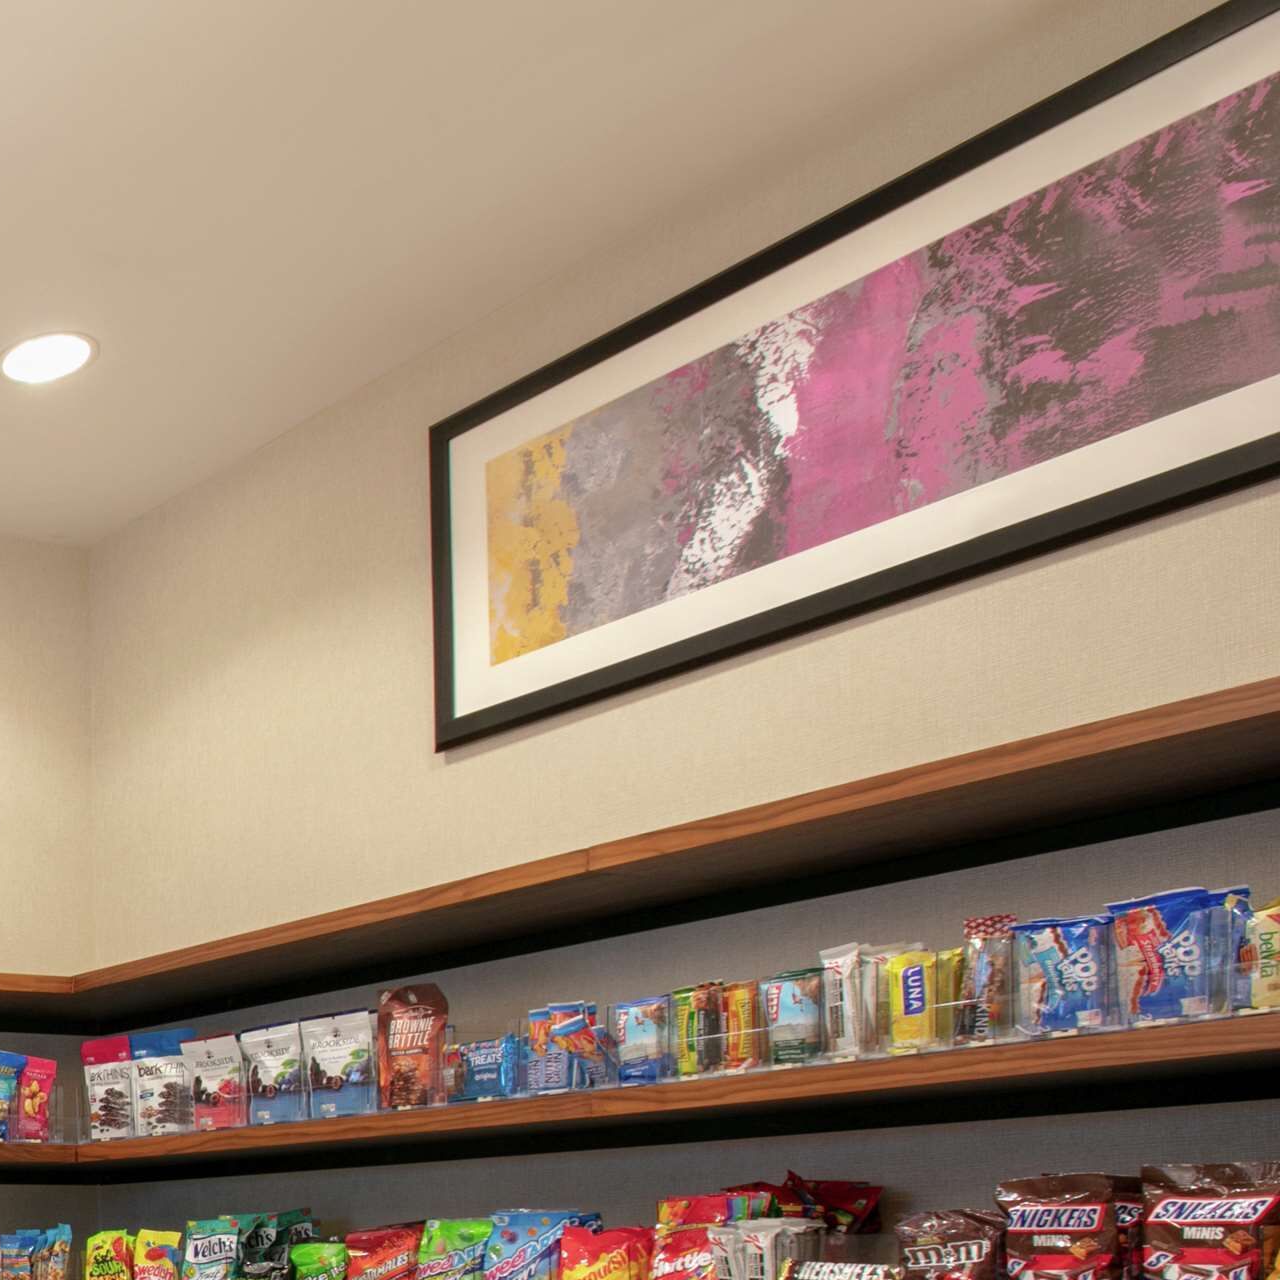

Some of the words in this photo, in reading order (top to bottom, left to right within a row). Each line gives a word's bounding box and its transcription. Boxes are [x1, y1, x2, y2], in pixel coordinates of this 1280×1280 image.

[906, 966, 922, 1010] LUNA
[390, 1016, 437, 1033] BROWNIE
[470, 1053, 503, 1067] TREATS
[1007, 1207, 1098, 1229] SNICKERS
[1154, 1200, 1271, 1221] SNICKERS
[1032, 1234, 1072, 1247] MINIS
[1182, 1226, 1225, 1240] MINIS
[92, 1261, 122, 1275] SOUR
[134, 1264, 175, 1280] Swedish
